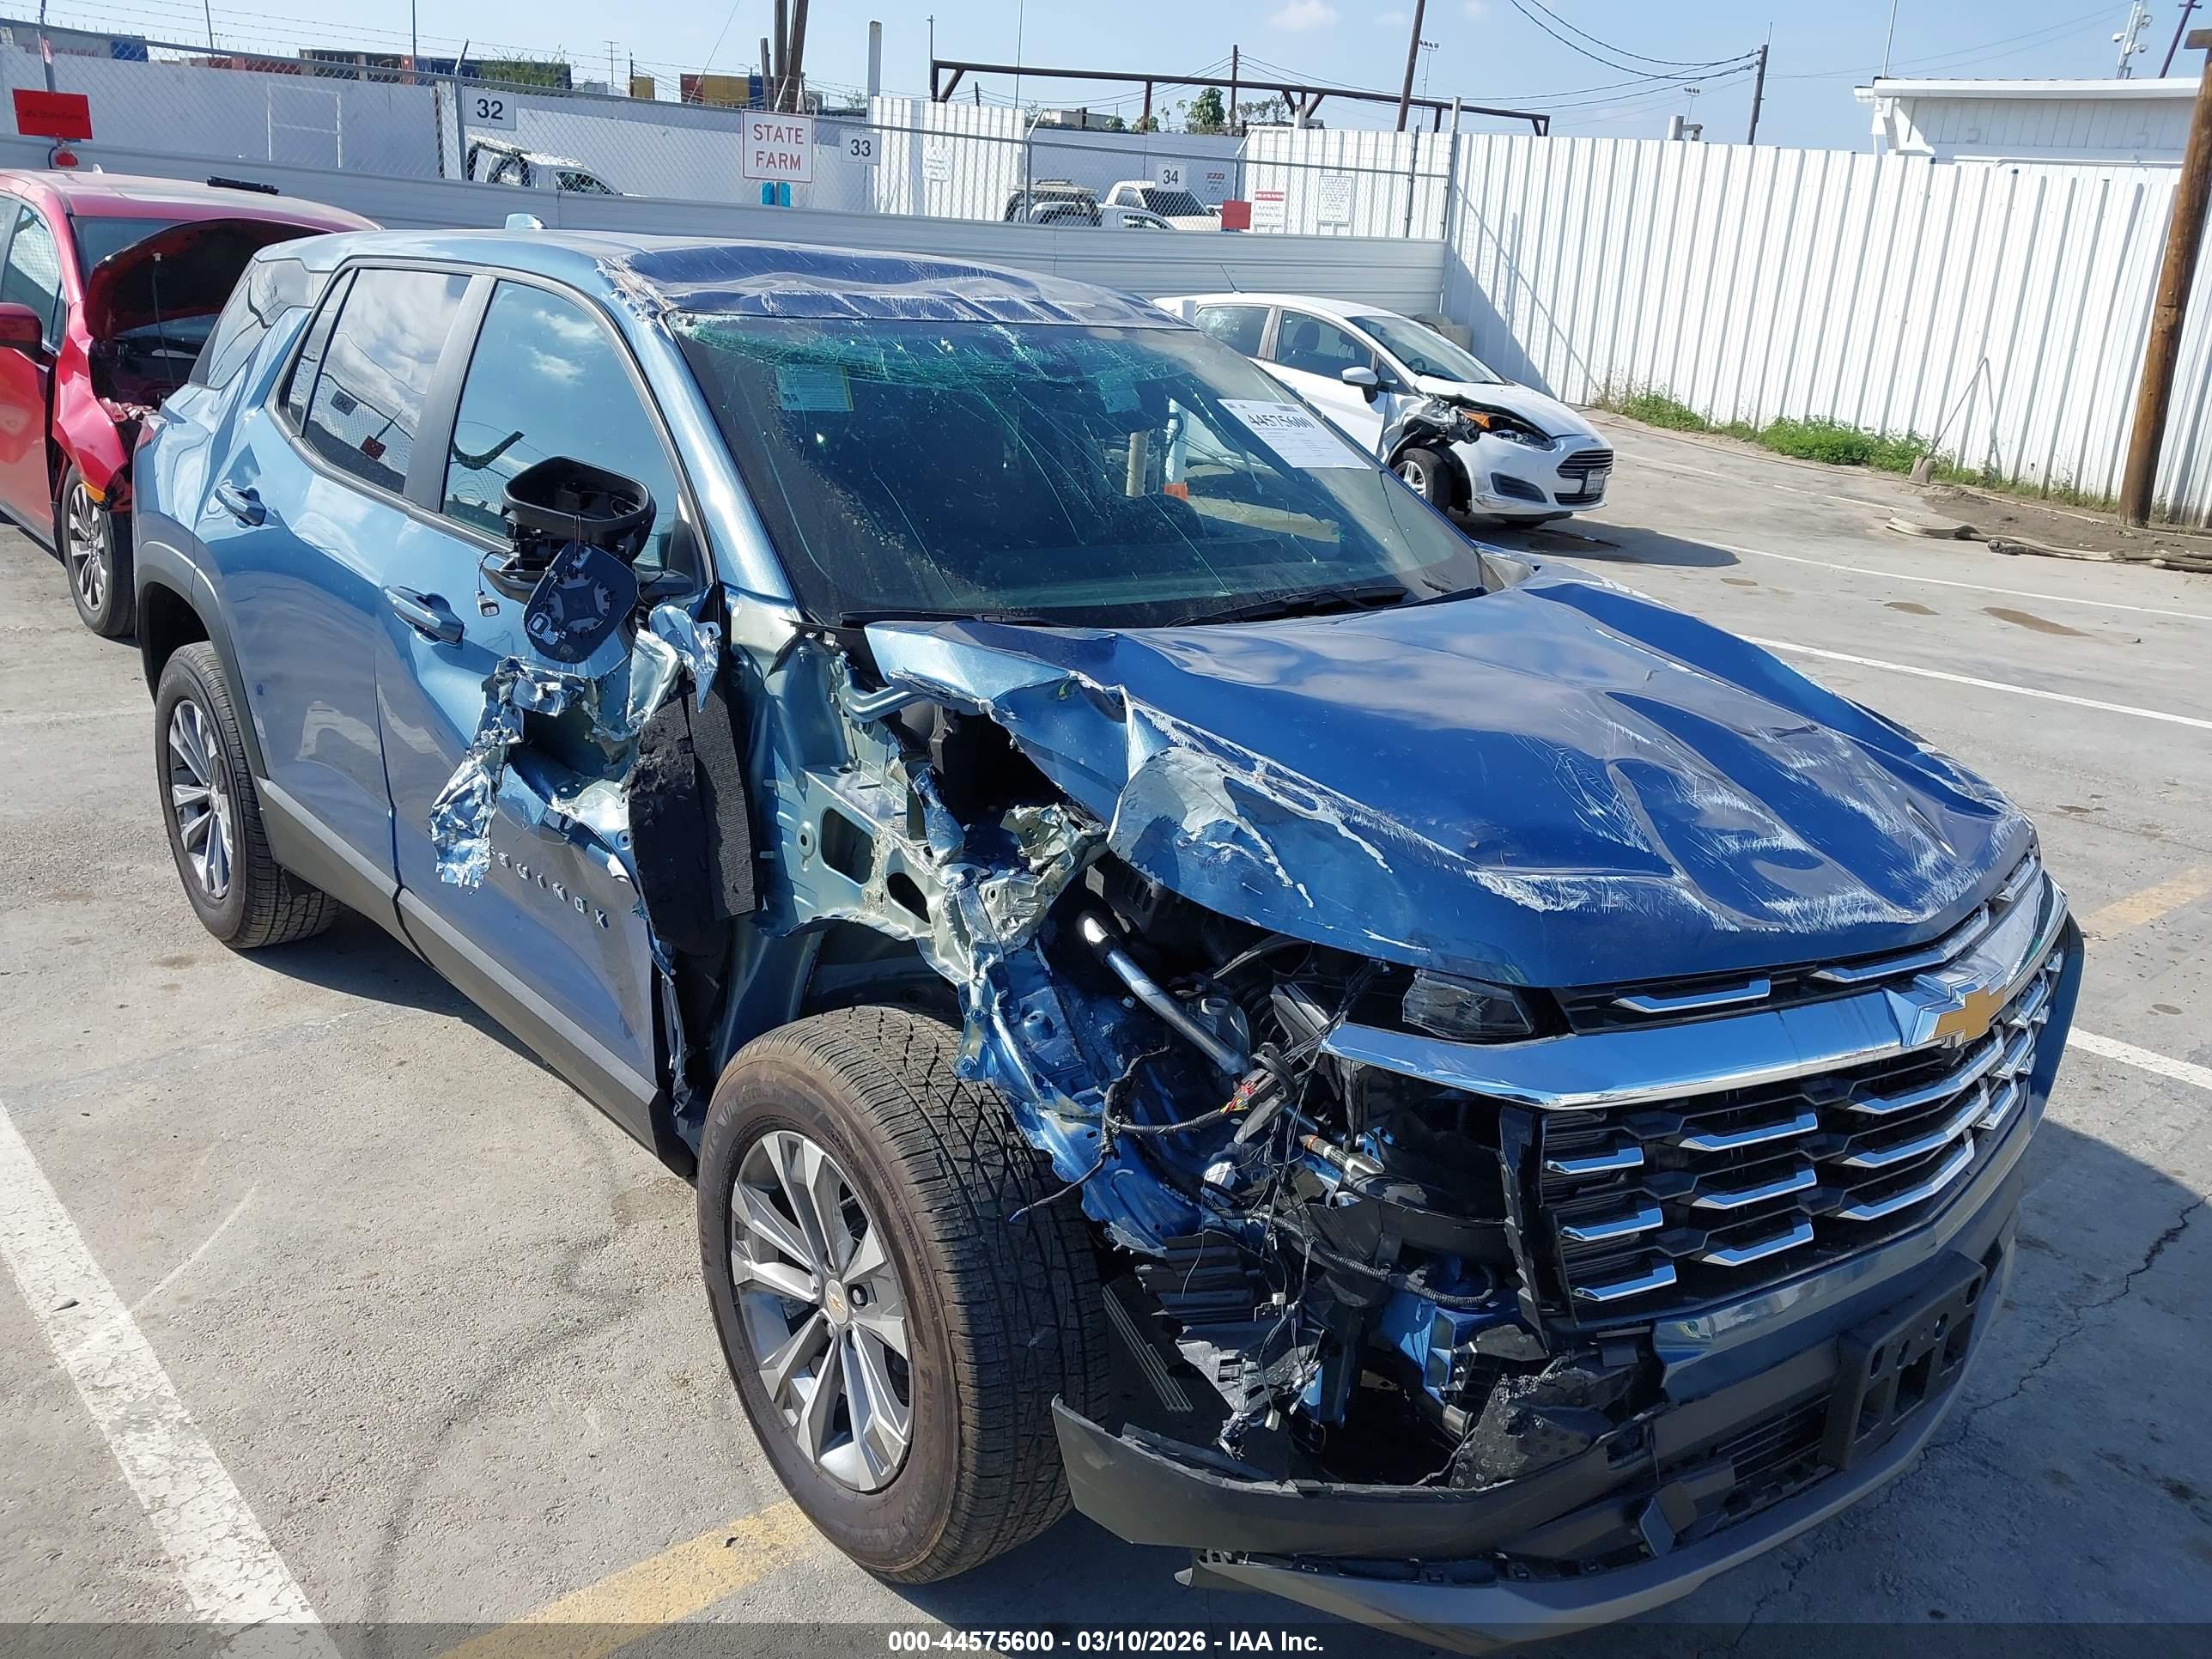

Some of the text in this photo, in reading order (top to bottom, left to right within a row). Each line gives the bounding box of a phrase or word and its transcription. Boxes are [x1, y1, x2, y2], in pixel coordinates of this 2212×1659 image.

[476, 98, 504, 121] 32
[753, 123, 804, 145] STATE
[850, 138, 872, 157] 33
[755, 150, 801, 171] FARM
[1162, 169, 1179, 185] 34
[1247, 413, 1316, 429] 44575600
